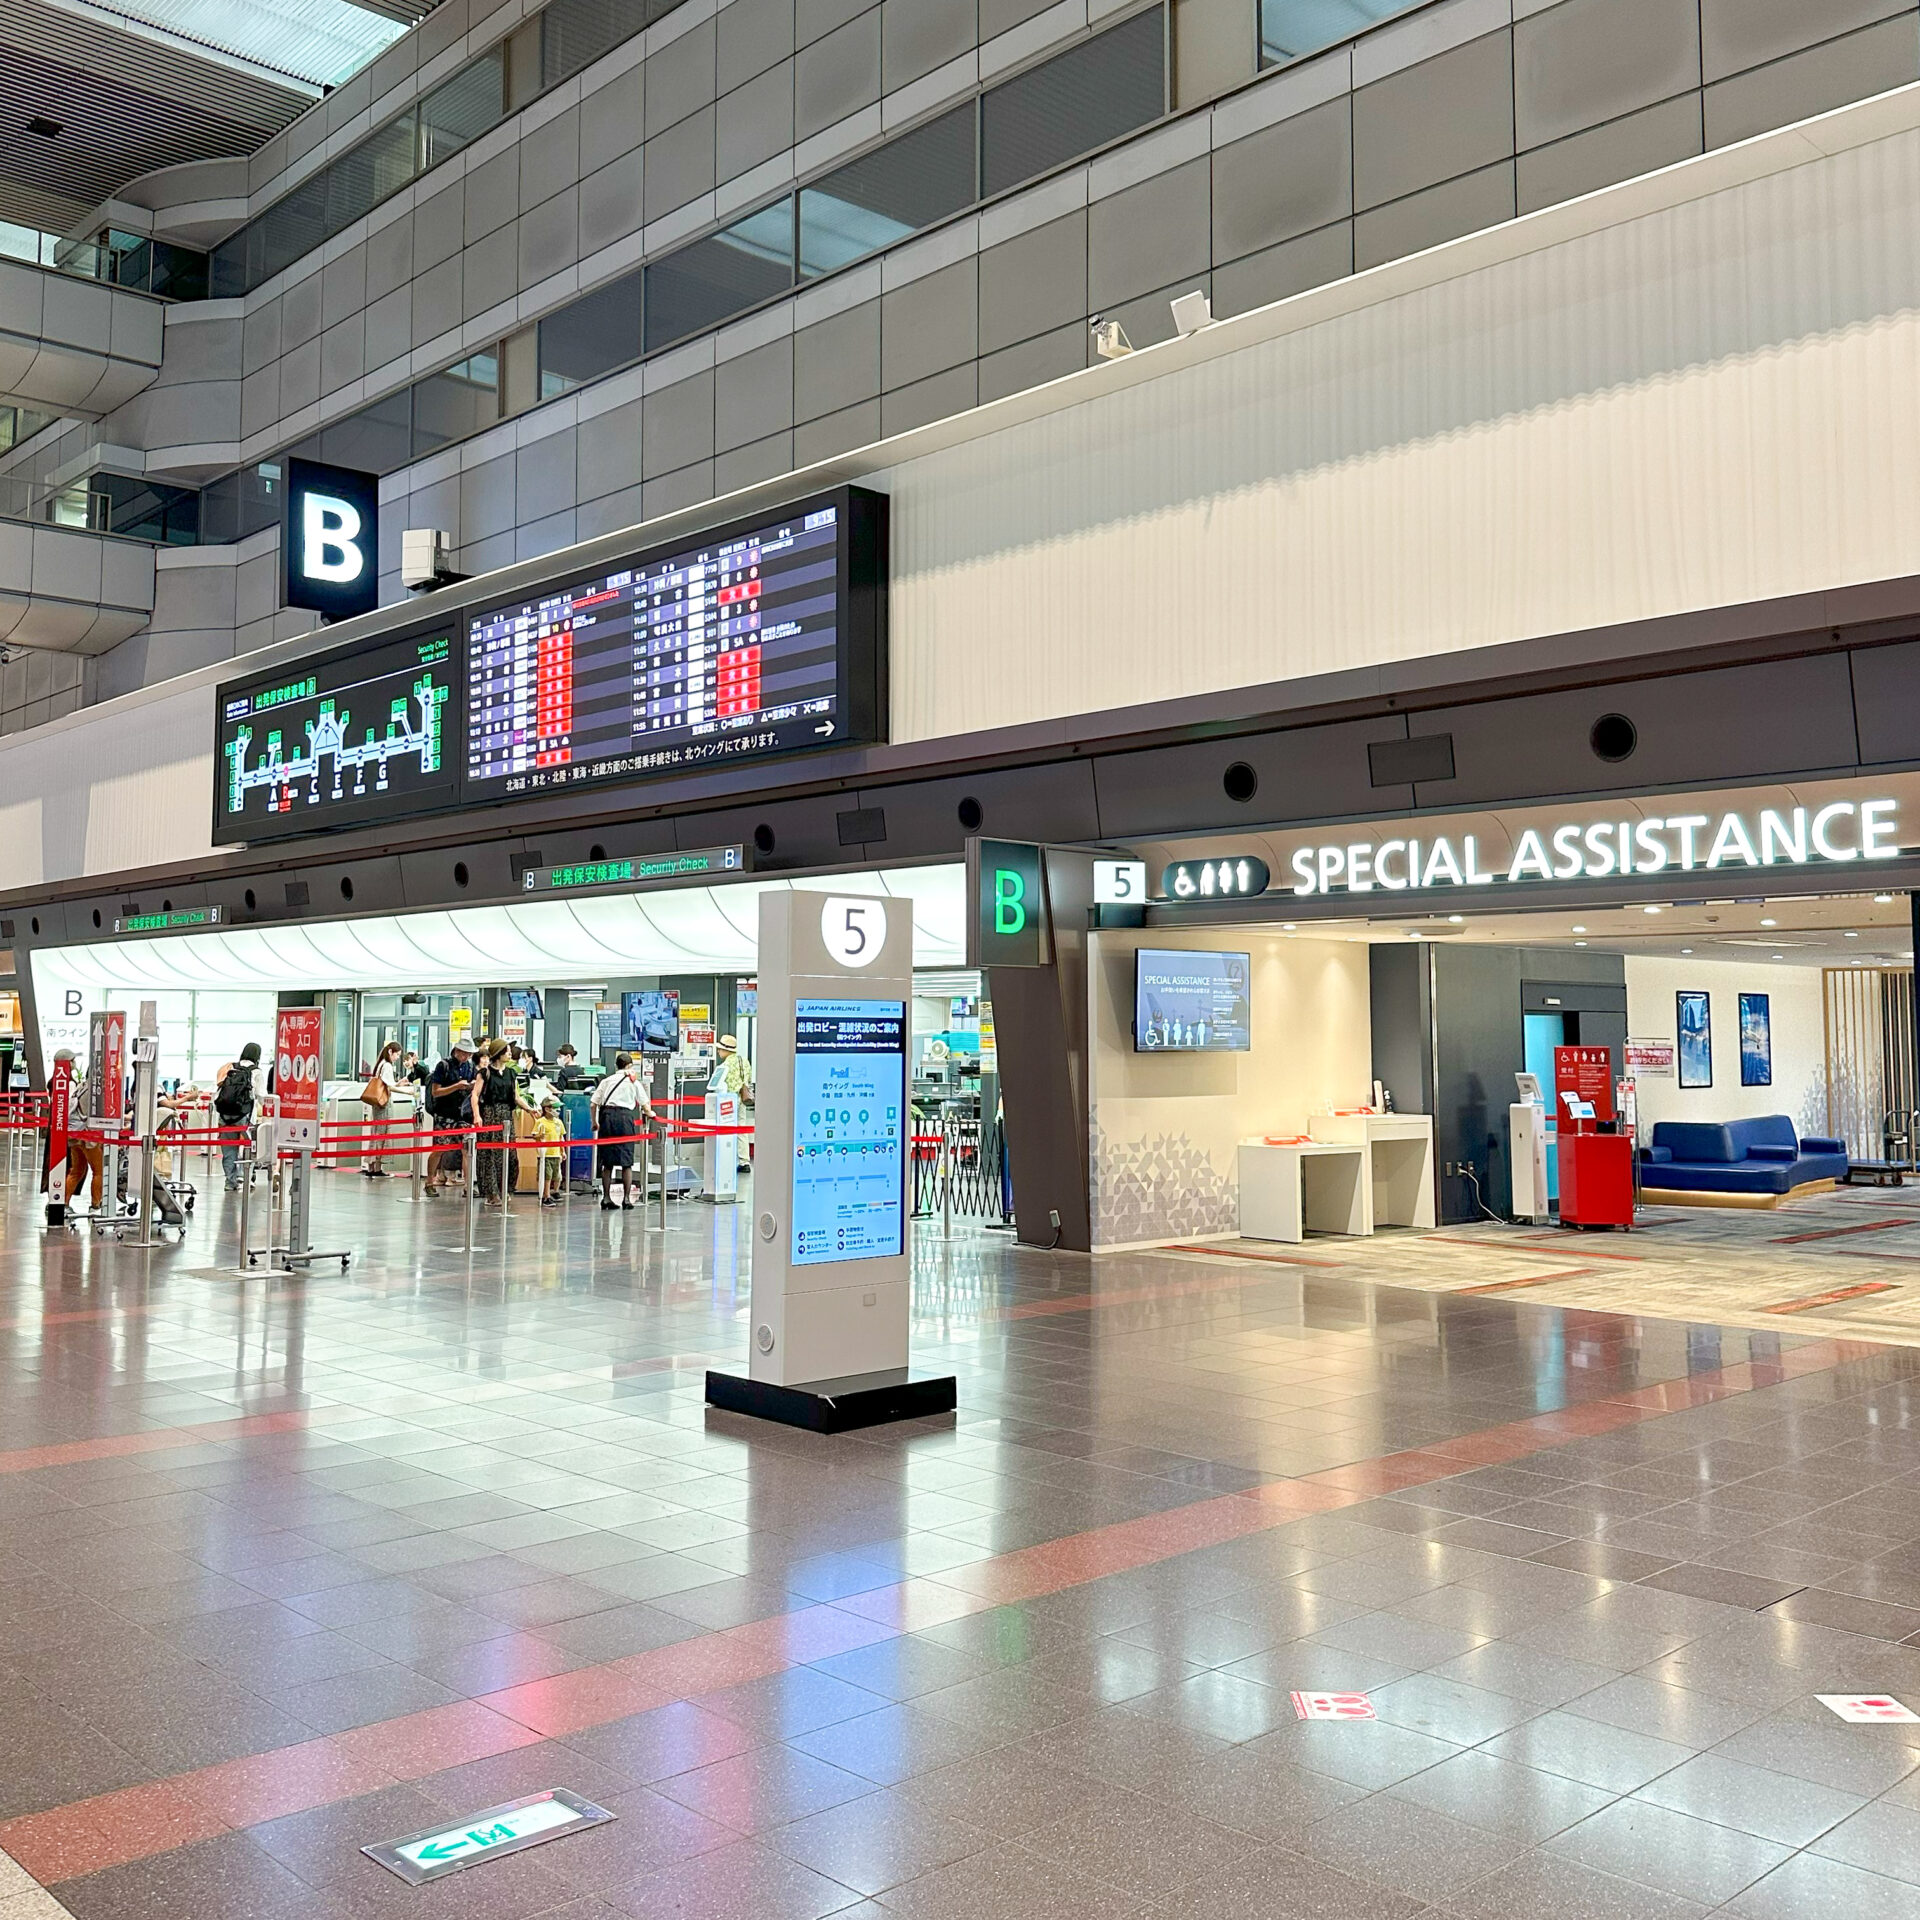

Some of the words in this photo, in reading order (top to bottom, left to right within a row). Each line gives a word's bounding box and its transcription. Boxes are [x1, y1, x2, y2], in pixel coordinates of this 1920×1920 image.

[303, 492, 363, 582] B
[356, 768, 363, 785] F
[378, 763, 387, 780] G
[310, 778, 318, 794] C
[334, 773, 341, 789] E
[270, 787, 278, 802] A
[1291, 834, 1494, 897] SPECIAL
[1507, 798, 1901, 883] ASSISTANCE
[526, 871, 535, 889] B
[551, 861, 631, 887] 出発保安検査場
[639, 860, 677, 877] Security
[678, 856, 709, 871] Check
[724, 848, 735, 869] B
[1114, 867, 1131, 898] 5
[995, 869, 1026, 934] B
[211, 907, 218, 922] B
[844, 908, 866, 955] 5
[1144, 975, 1172, 985] SPECIAL
[1172, 976, 1211, 986] ASSISTANCE
[65, 989, 83, 1016] B
[289, 1015, 320, 1030] 専用レーン
[797, 1021, 838, 1033] 出発ロビー
[296, 1034, 311, 1047] 入口
[55, 1066, 68, 1091] 入口
[56, 1093, 65, 1131] ENTRANCE
